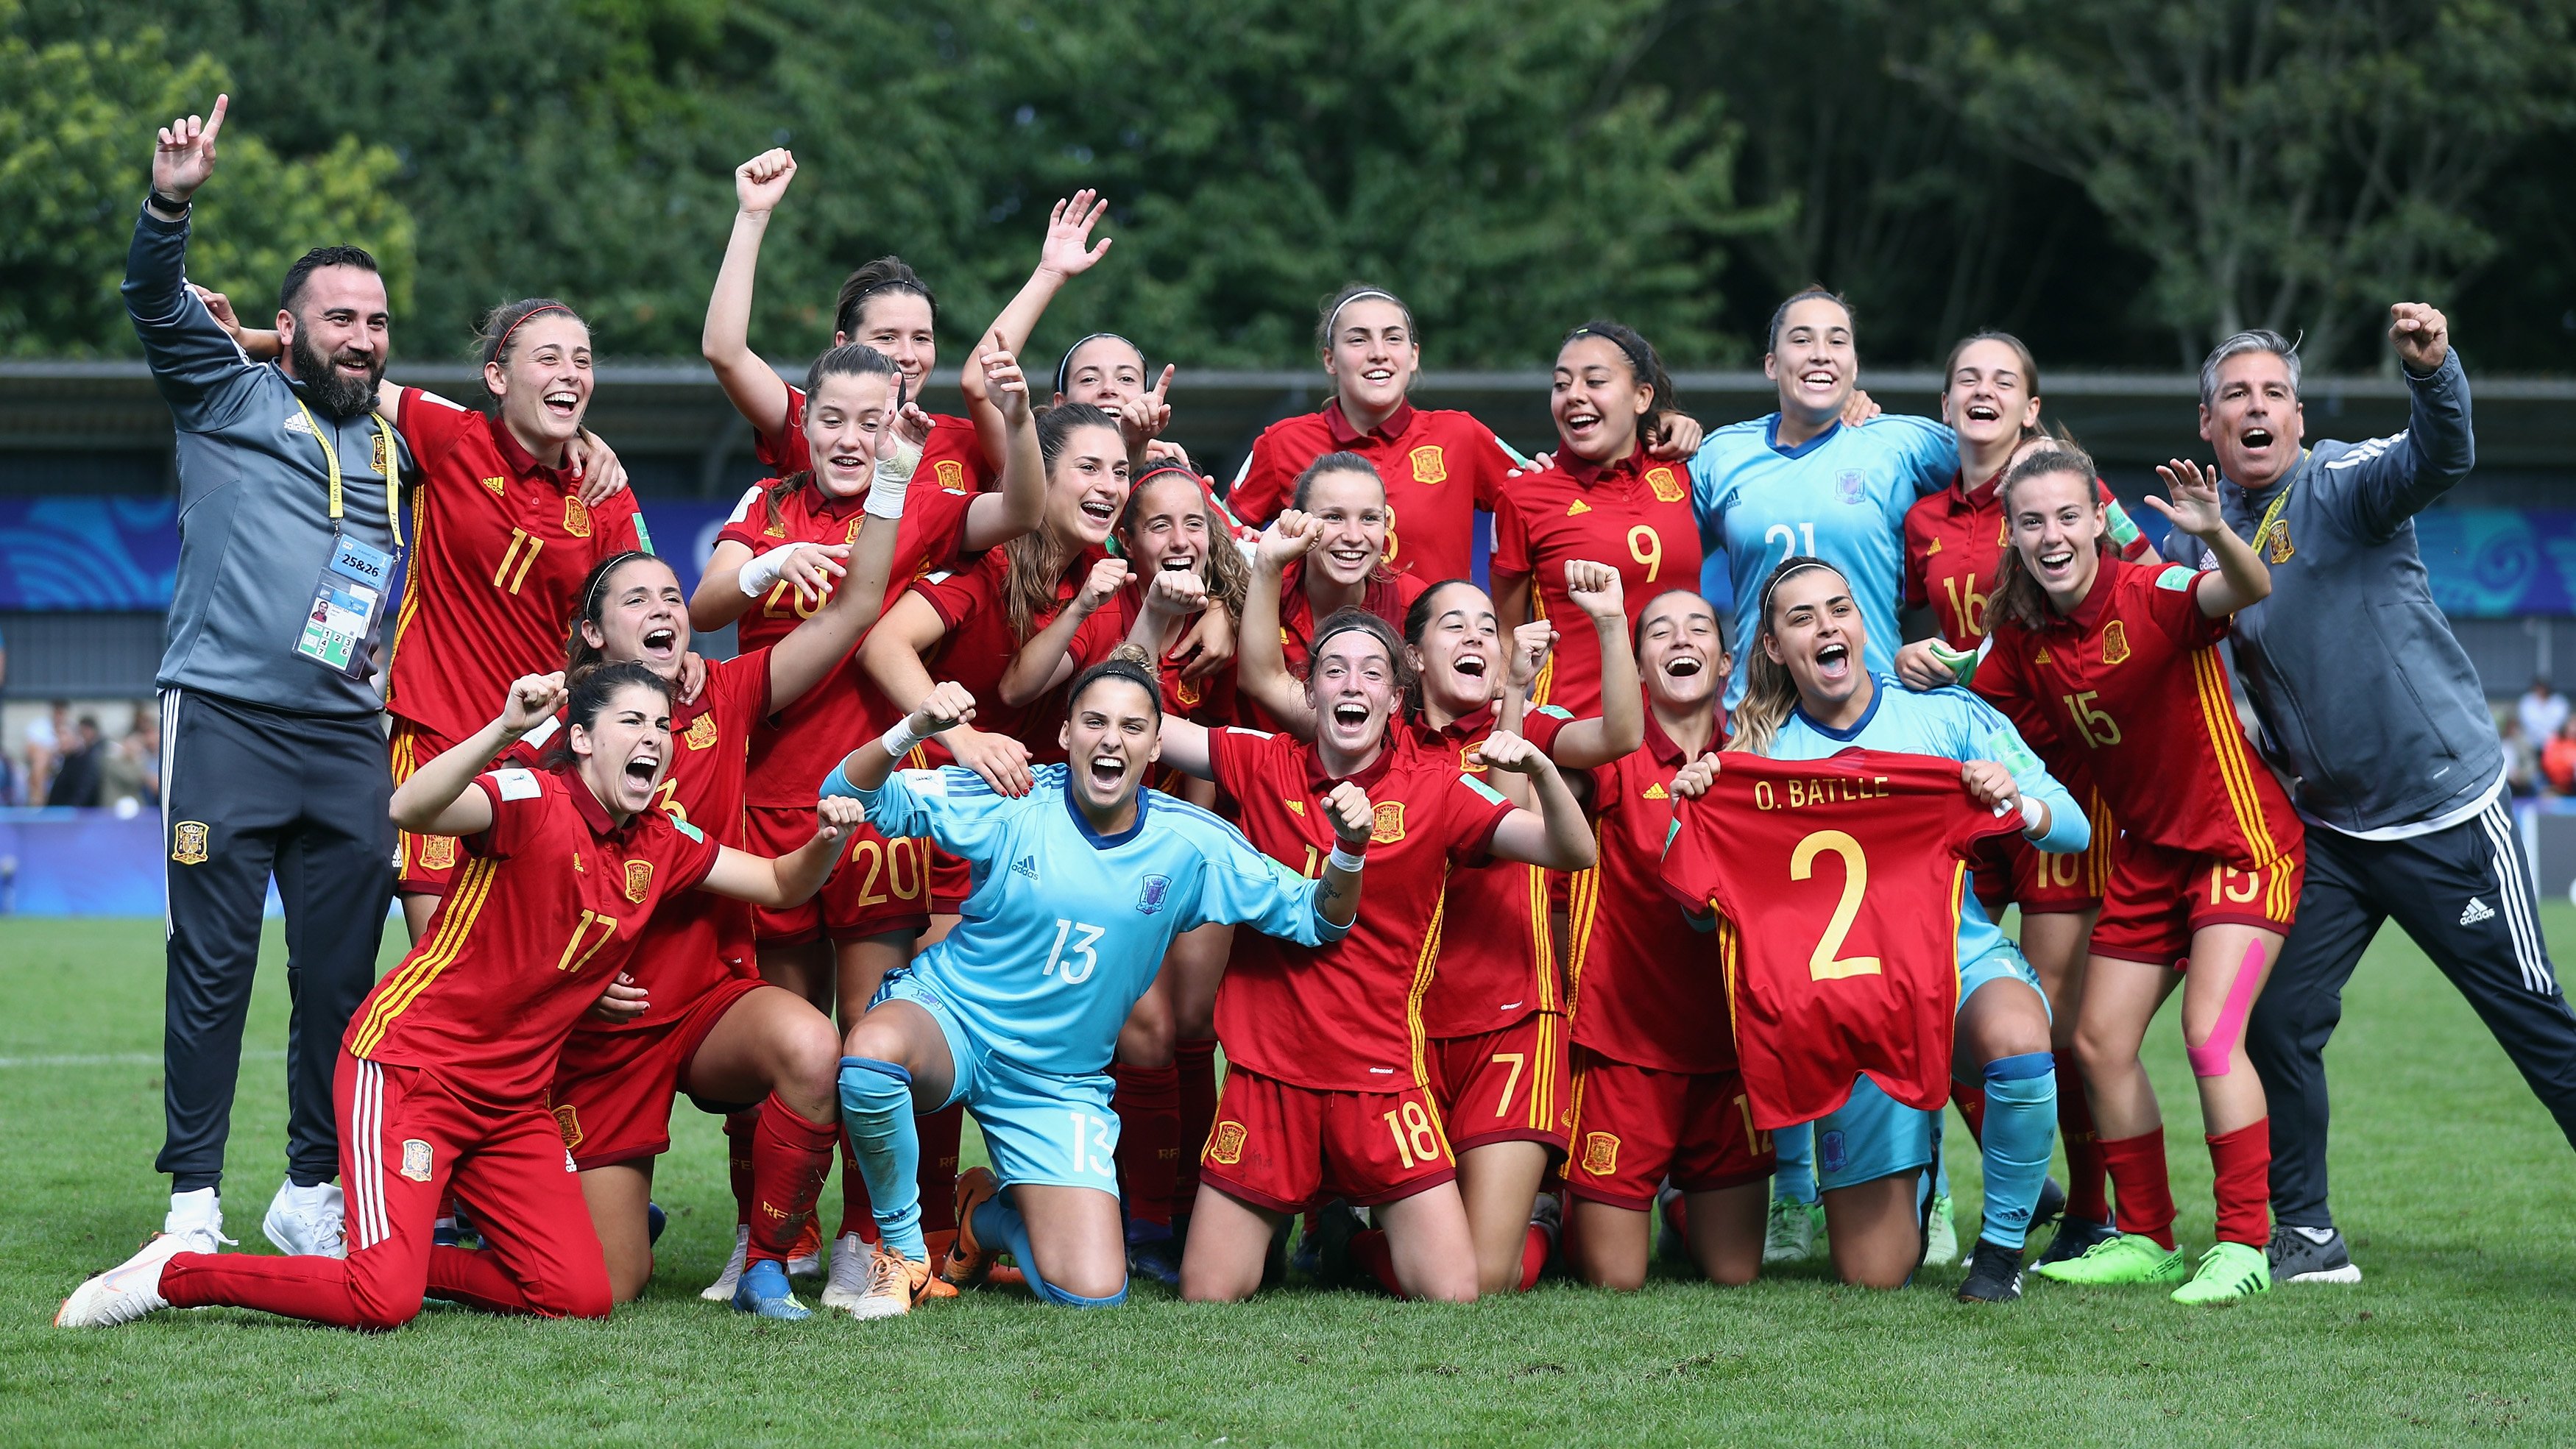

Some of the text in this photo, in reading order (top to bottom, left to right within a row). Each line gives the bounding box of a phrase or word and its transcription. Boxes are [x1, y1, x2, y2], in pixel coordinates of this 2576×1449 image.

[482, 478, 505, 497] adidas
[1627, 524, 1662, 584] 9
[1765, 522, 1816, 564] 21
[2254, 528, 2268, 550] WORLD
[2265, 512, 2275, 528] CUP
[342, 553, 380, 578] 25&26
[494, 526, 545, 595] 11
[2199, 561, 2219, 571] adid
[763, 566, 829, 620] 20
[1943, 573, 1988, 638] 16
[2063, 690, 2122, 749] 15
[1754, 776, 1889, 811] O. BATLLE
[852, 835, 920, 907] 20
[1011, 862, 1039, 881] addas
[1303, 843, 1331, 879] 1
[2210, 857, 2260, 906] 15
[1790, 829, 1882, 982] 2
[2460, 907, 2495, 926] adidas
[557, 908, 618, 973] 17
[1042, 918, 1105, 985] 13
[1492, 1053, 1524, 1118] 7
[1069, 1112, 1115, 1177] 13
[1159, 1148, 1180, 1160] RF
[1383, 1100, 1440, 1169] 18
